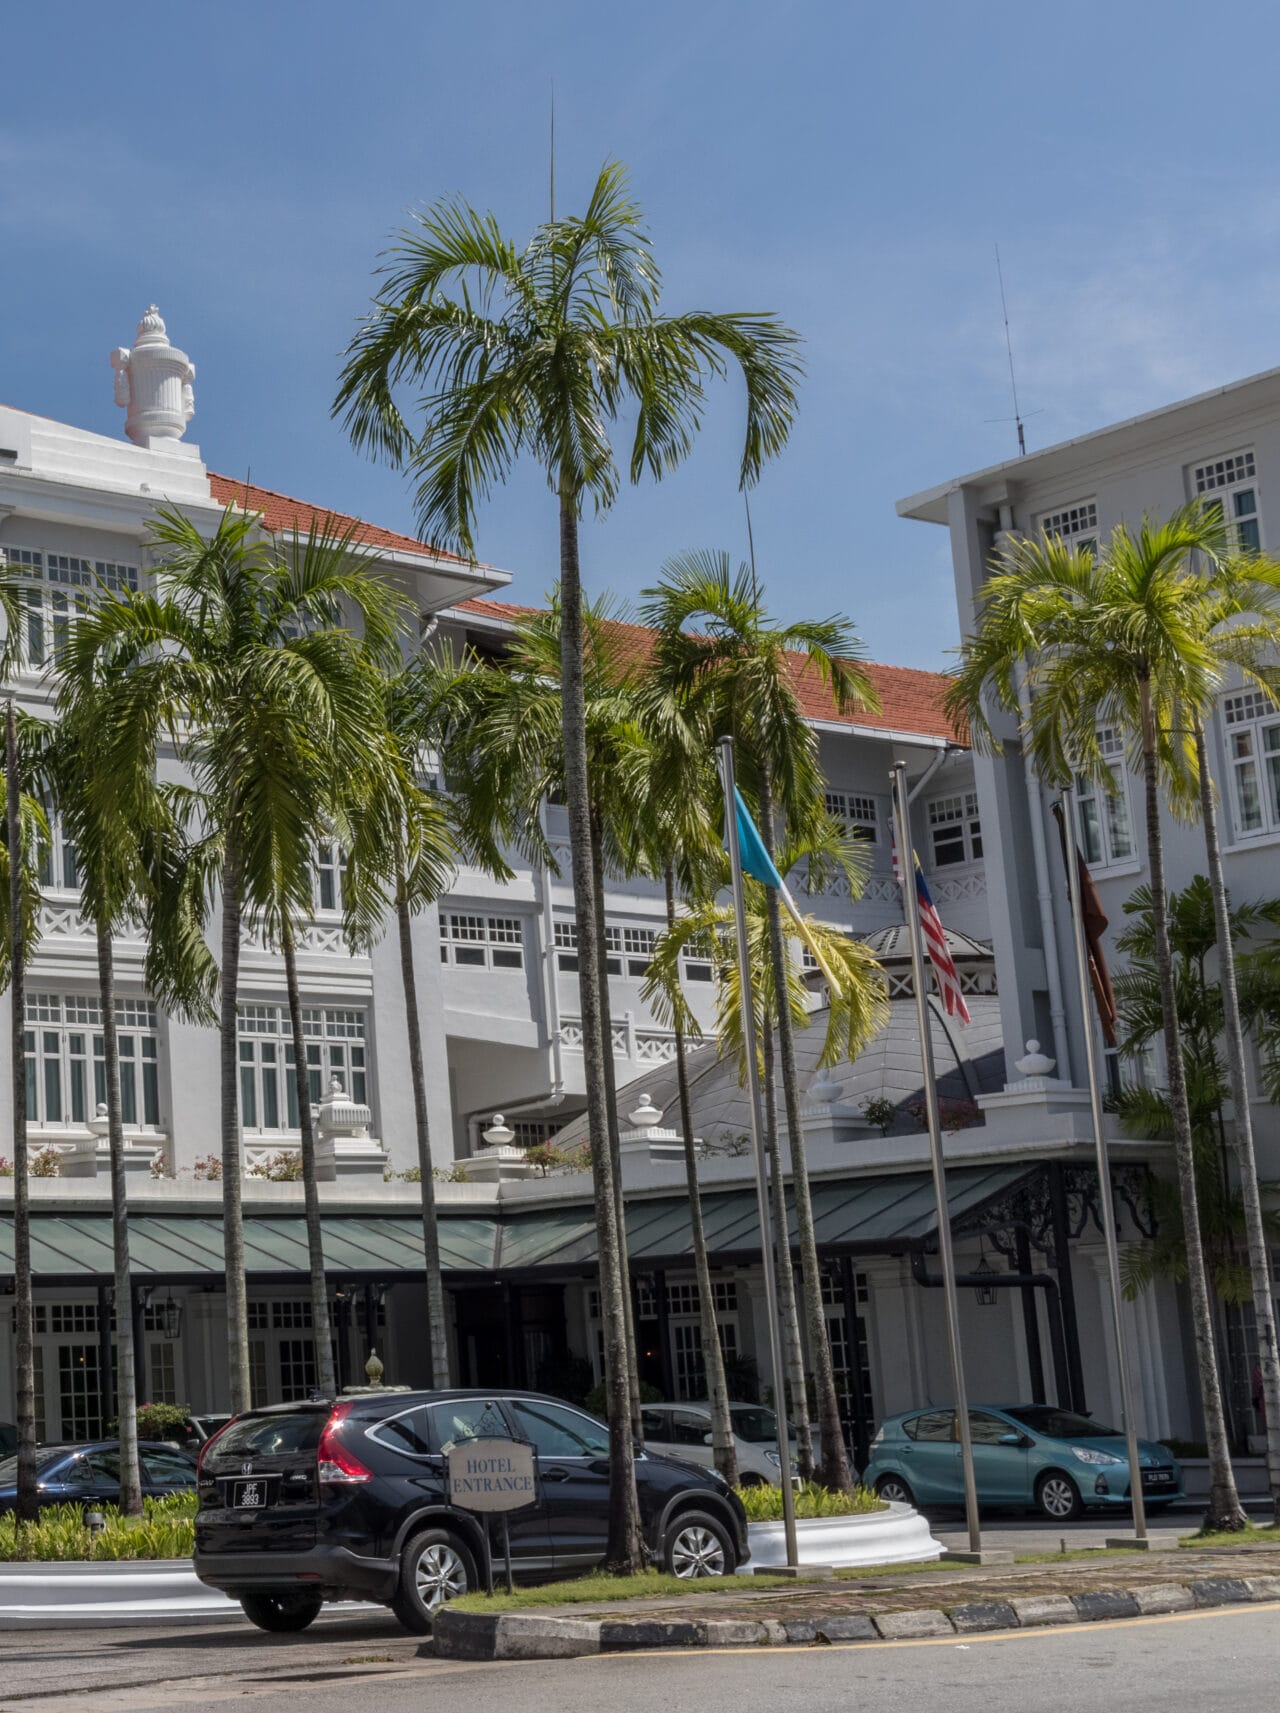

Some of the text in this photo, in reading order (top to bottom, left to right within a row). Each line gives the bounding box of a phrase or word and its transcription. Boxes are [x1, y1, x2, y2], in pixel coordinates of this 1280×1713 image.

[466, 1458, 516, 1474] HOTEL
[244, 1483, 258, 1495] JPF
[453, 1476, 533, 1493] ENTRANCE
[241, 1494, 260, 1505] 3893
